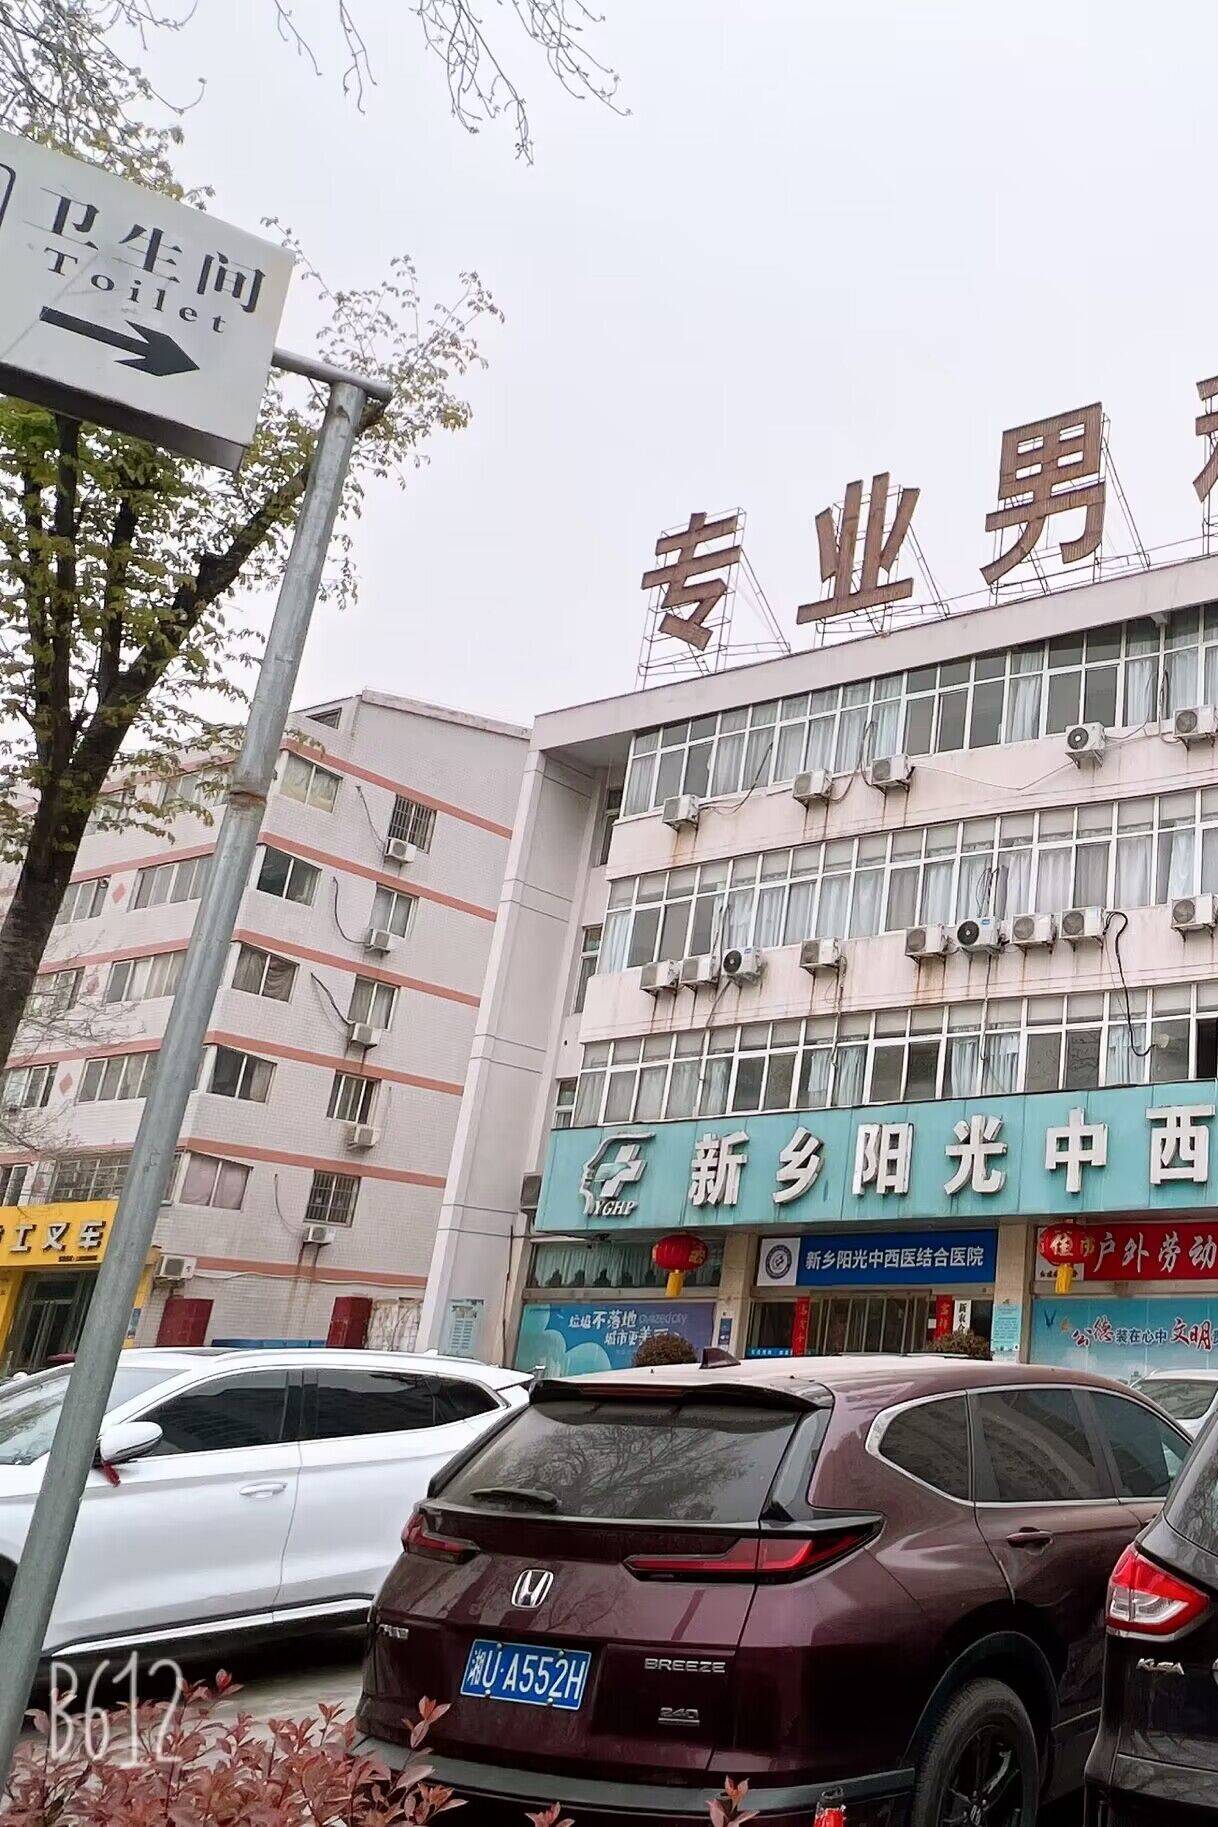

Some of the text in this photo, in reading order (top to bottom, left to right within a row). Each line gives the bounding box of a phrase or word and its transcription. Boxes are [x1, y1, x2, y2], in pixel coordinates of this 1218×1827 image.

[22, 185, 266, 314] 卫生间
[44, 246, 227, 335] Toilet
[0, 1221, 106, 1253] 工叉车
[806, 1245, 984, 1271] 新乡阳光中西医结合医院
[644, 1657, 727, 1674] BREEZE
[659, 1706, 700, 1720] 240
